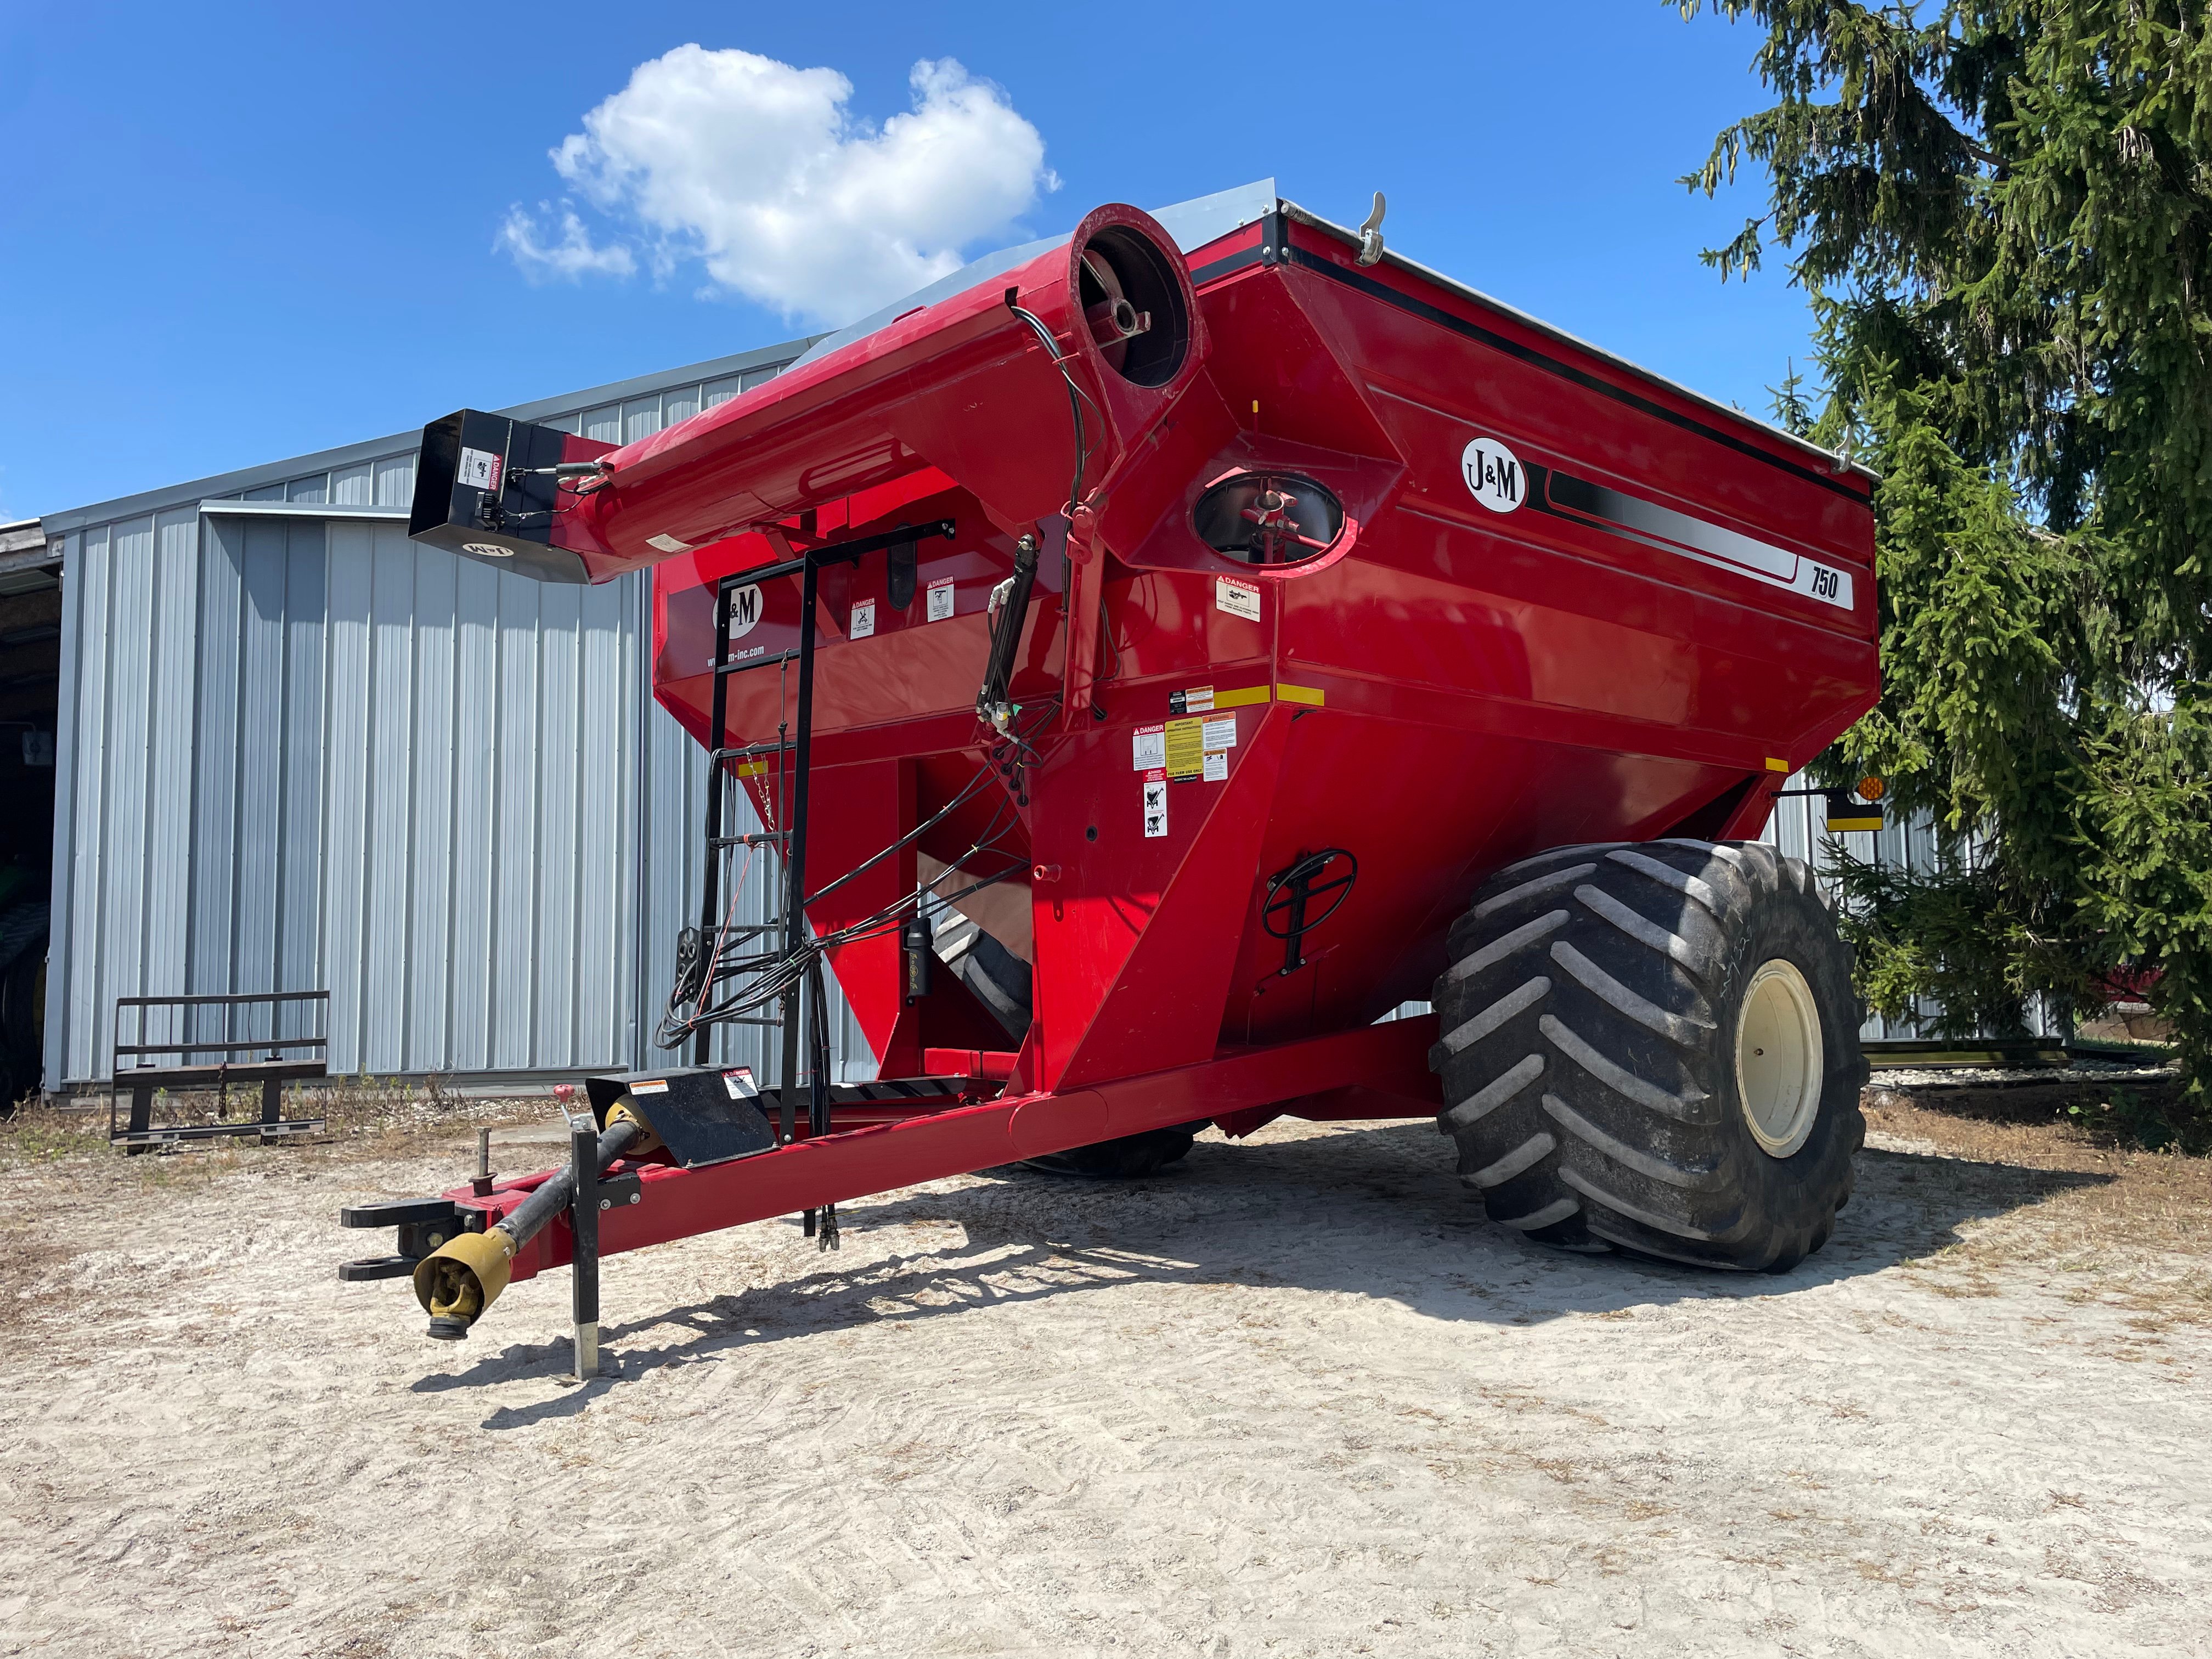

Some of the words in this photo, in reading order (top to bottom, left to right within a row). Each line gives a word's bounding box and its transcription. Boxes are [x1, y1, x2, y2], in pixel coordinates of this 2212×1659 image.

[490, 462, 500, 490] DANGER
[1466, 449, 1517, 503] J&M
[467, 545, 511, 555] J&M
[933, 577, 953, 588] DANGER
[1225, 577, 1259, 593] DANGER
[1812, 566, 1838, 599] 750
[729, 589, 756, 626] &M
[856, 597, 875, 608] DANGER
[1140, 724, 1164, 734] DANGER
